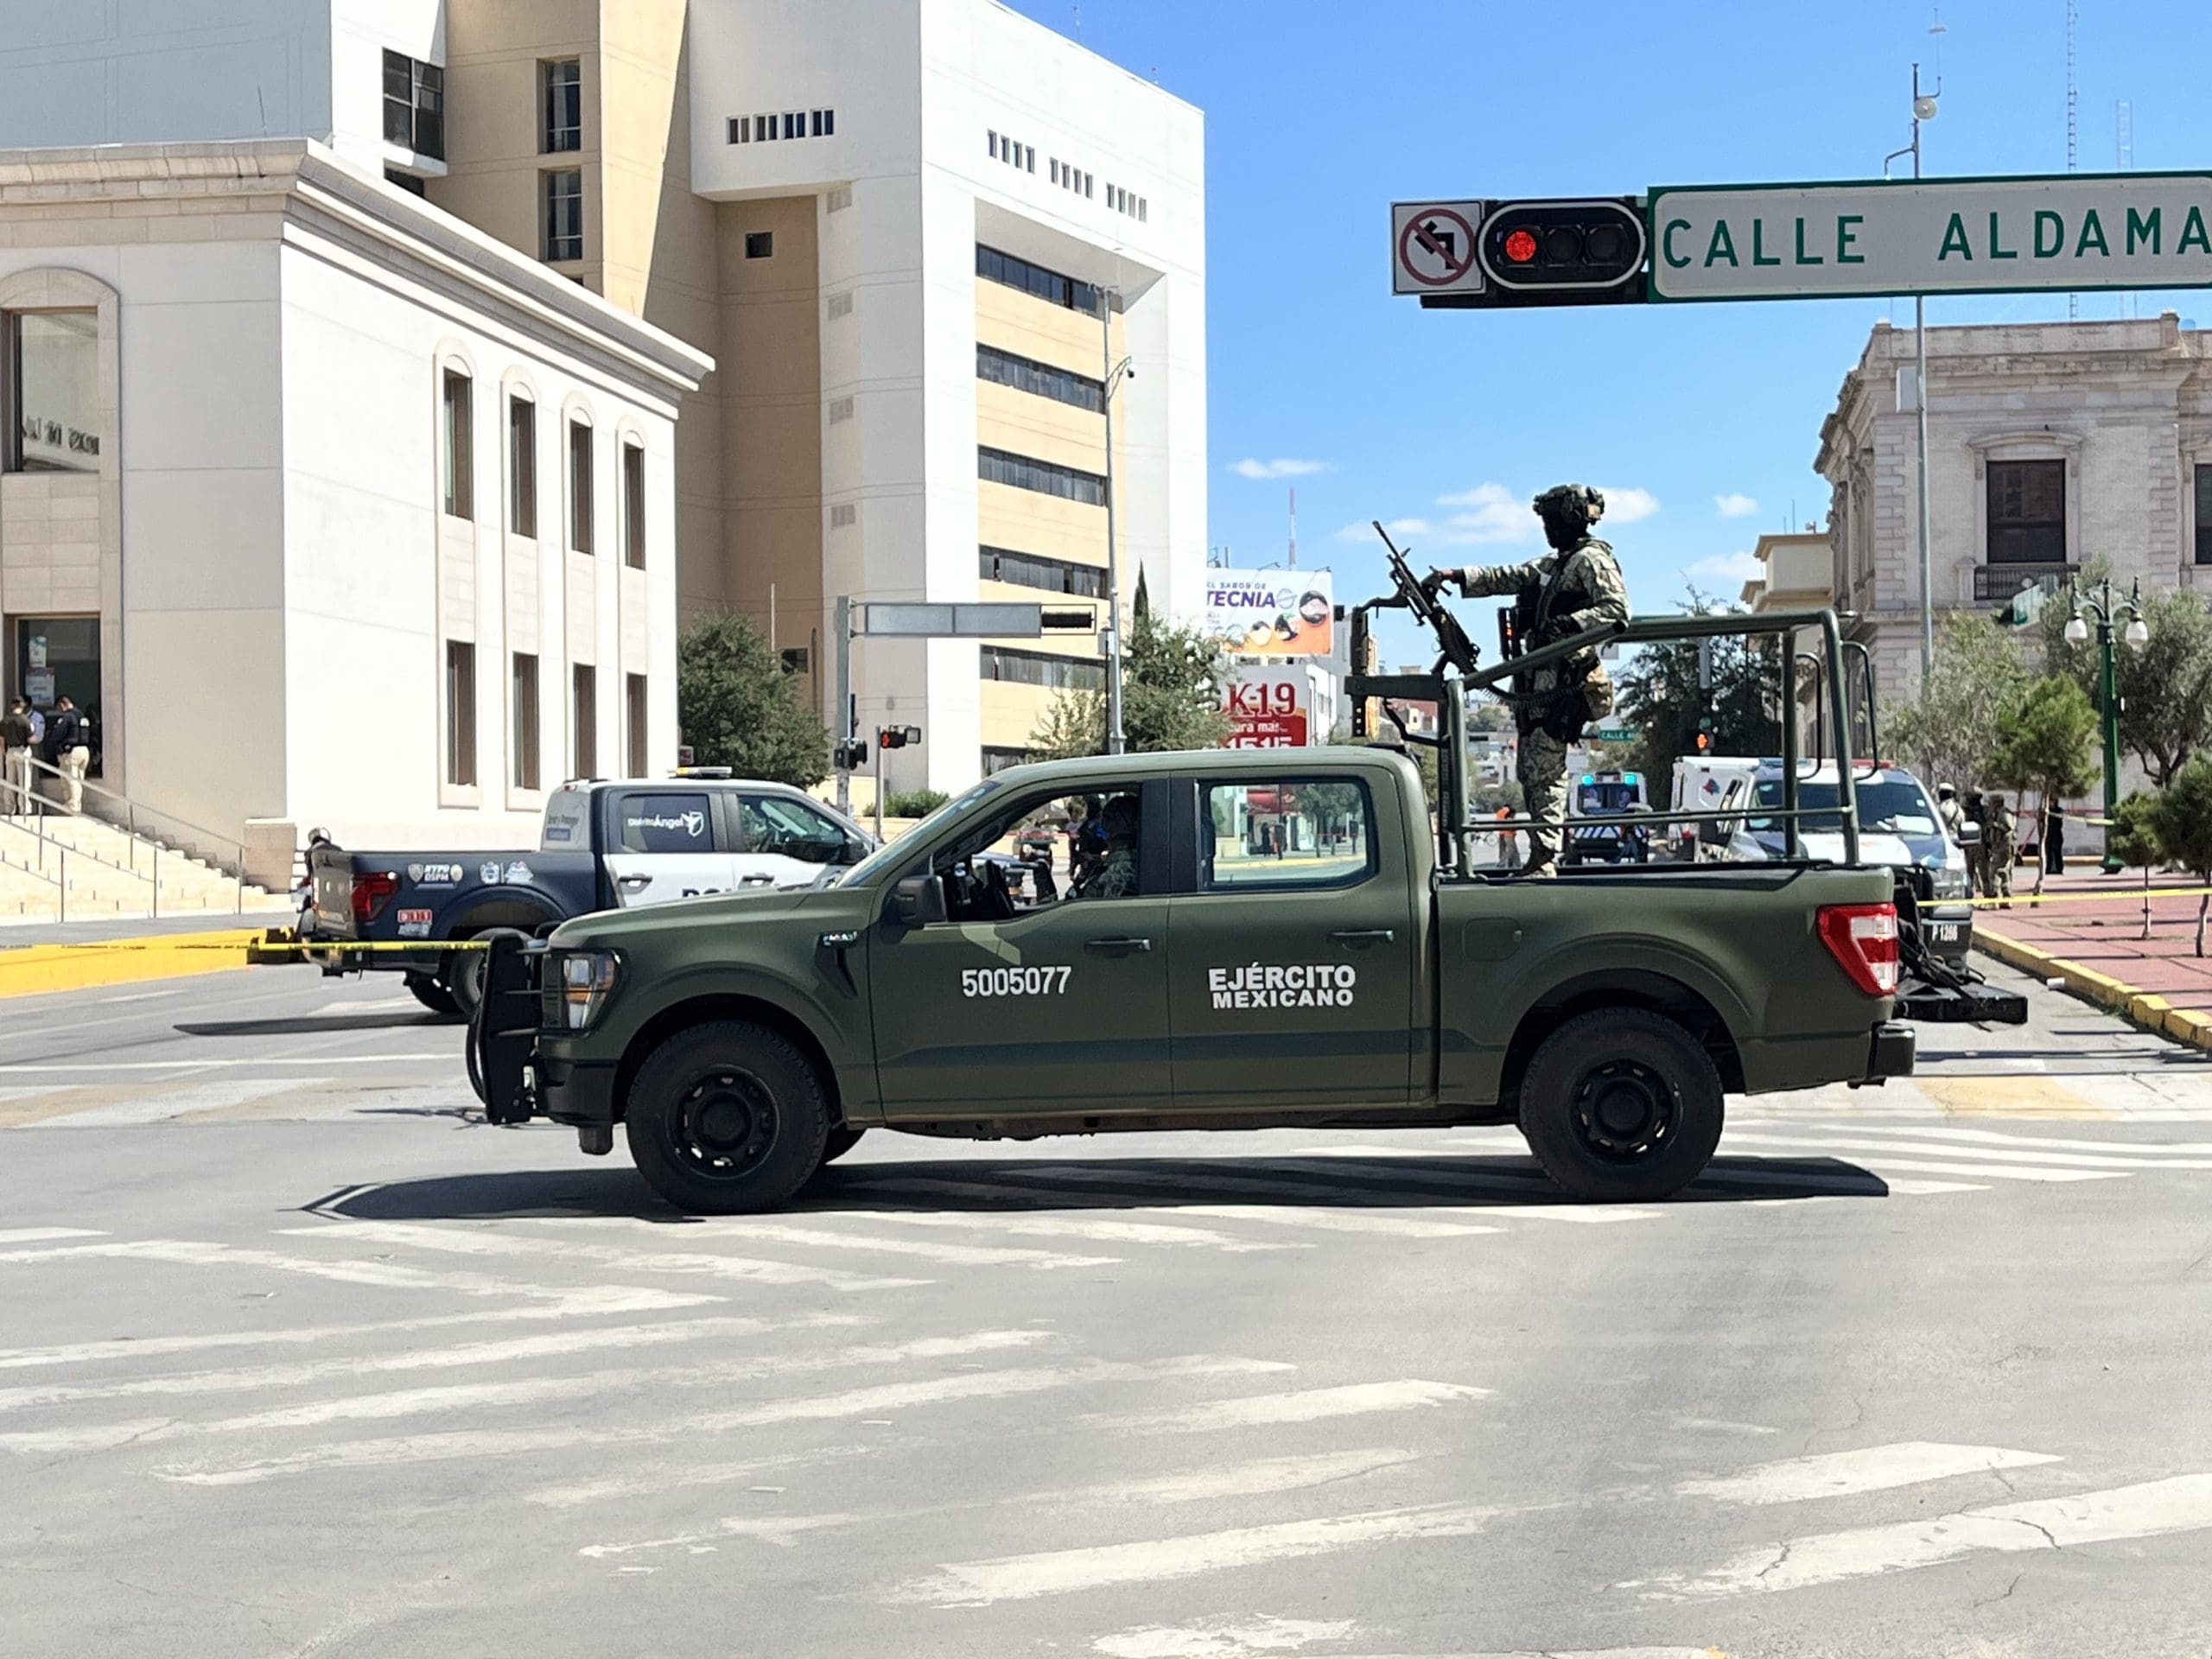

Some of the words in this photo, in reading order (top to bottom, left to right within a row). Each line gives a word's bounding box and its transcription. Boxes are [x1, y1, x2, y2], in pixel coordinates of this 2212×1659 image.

[1663, 215, 1866, 269] CALLE
[1938, 206, 2212, 261] ALDAMA
[962, 966, 1071, 997] 5005077
[1209, 962, 1356, 991] EJÉRCITO
[1213, 989, 1354, 1009] MEXICANO
